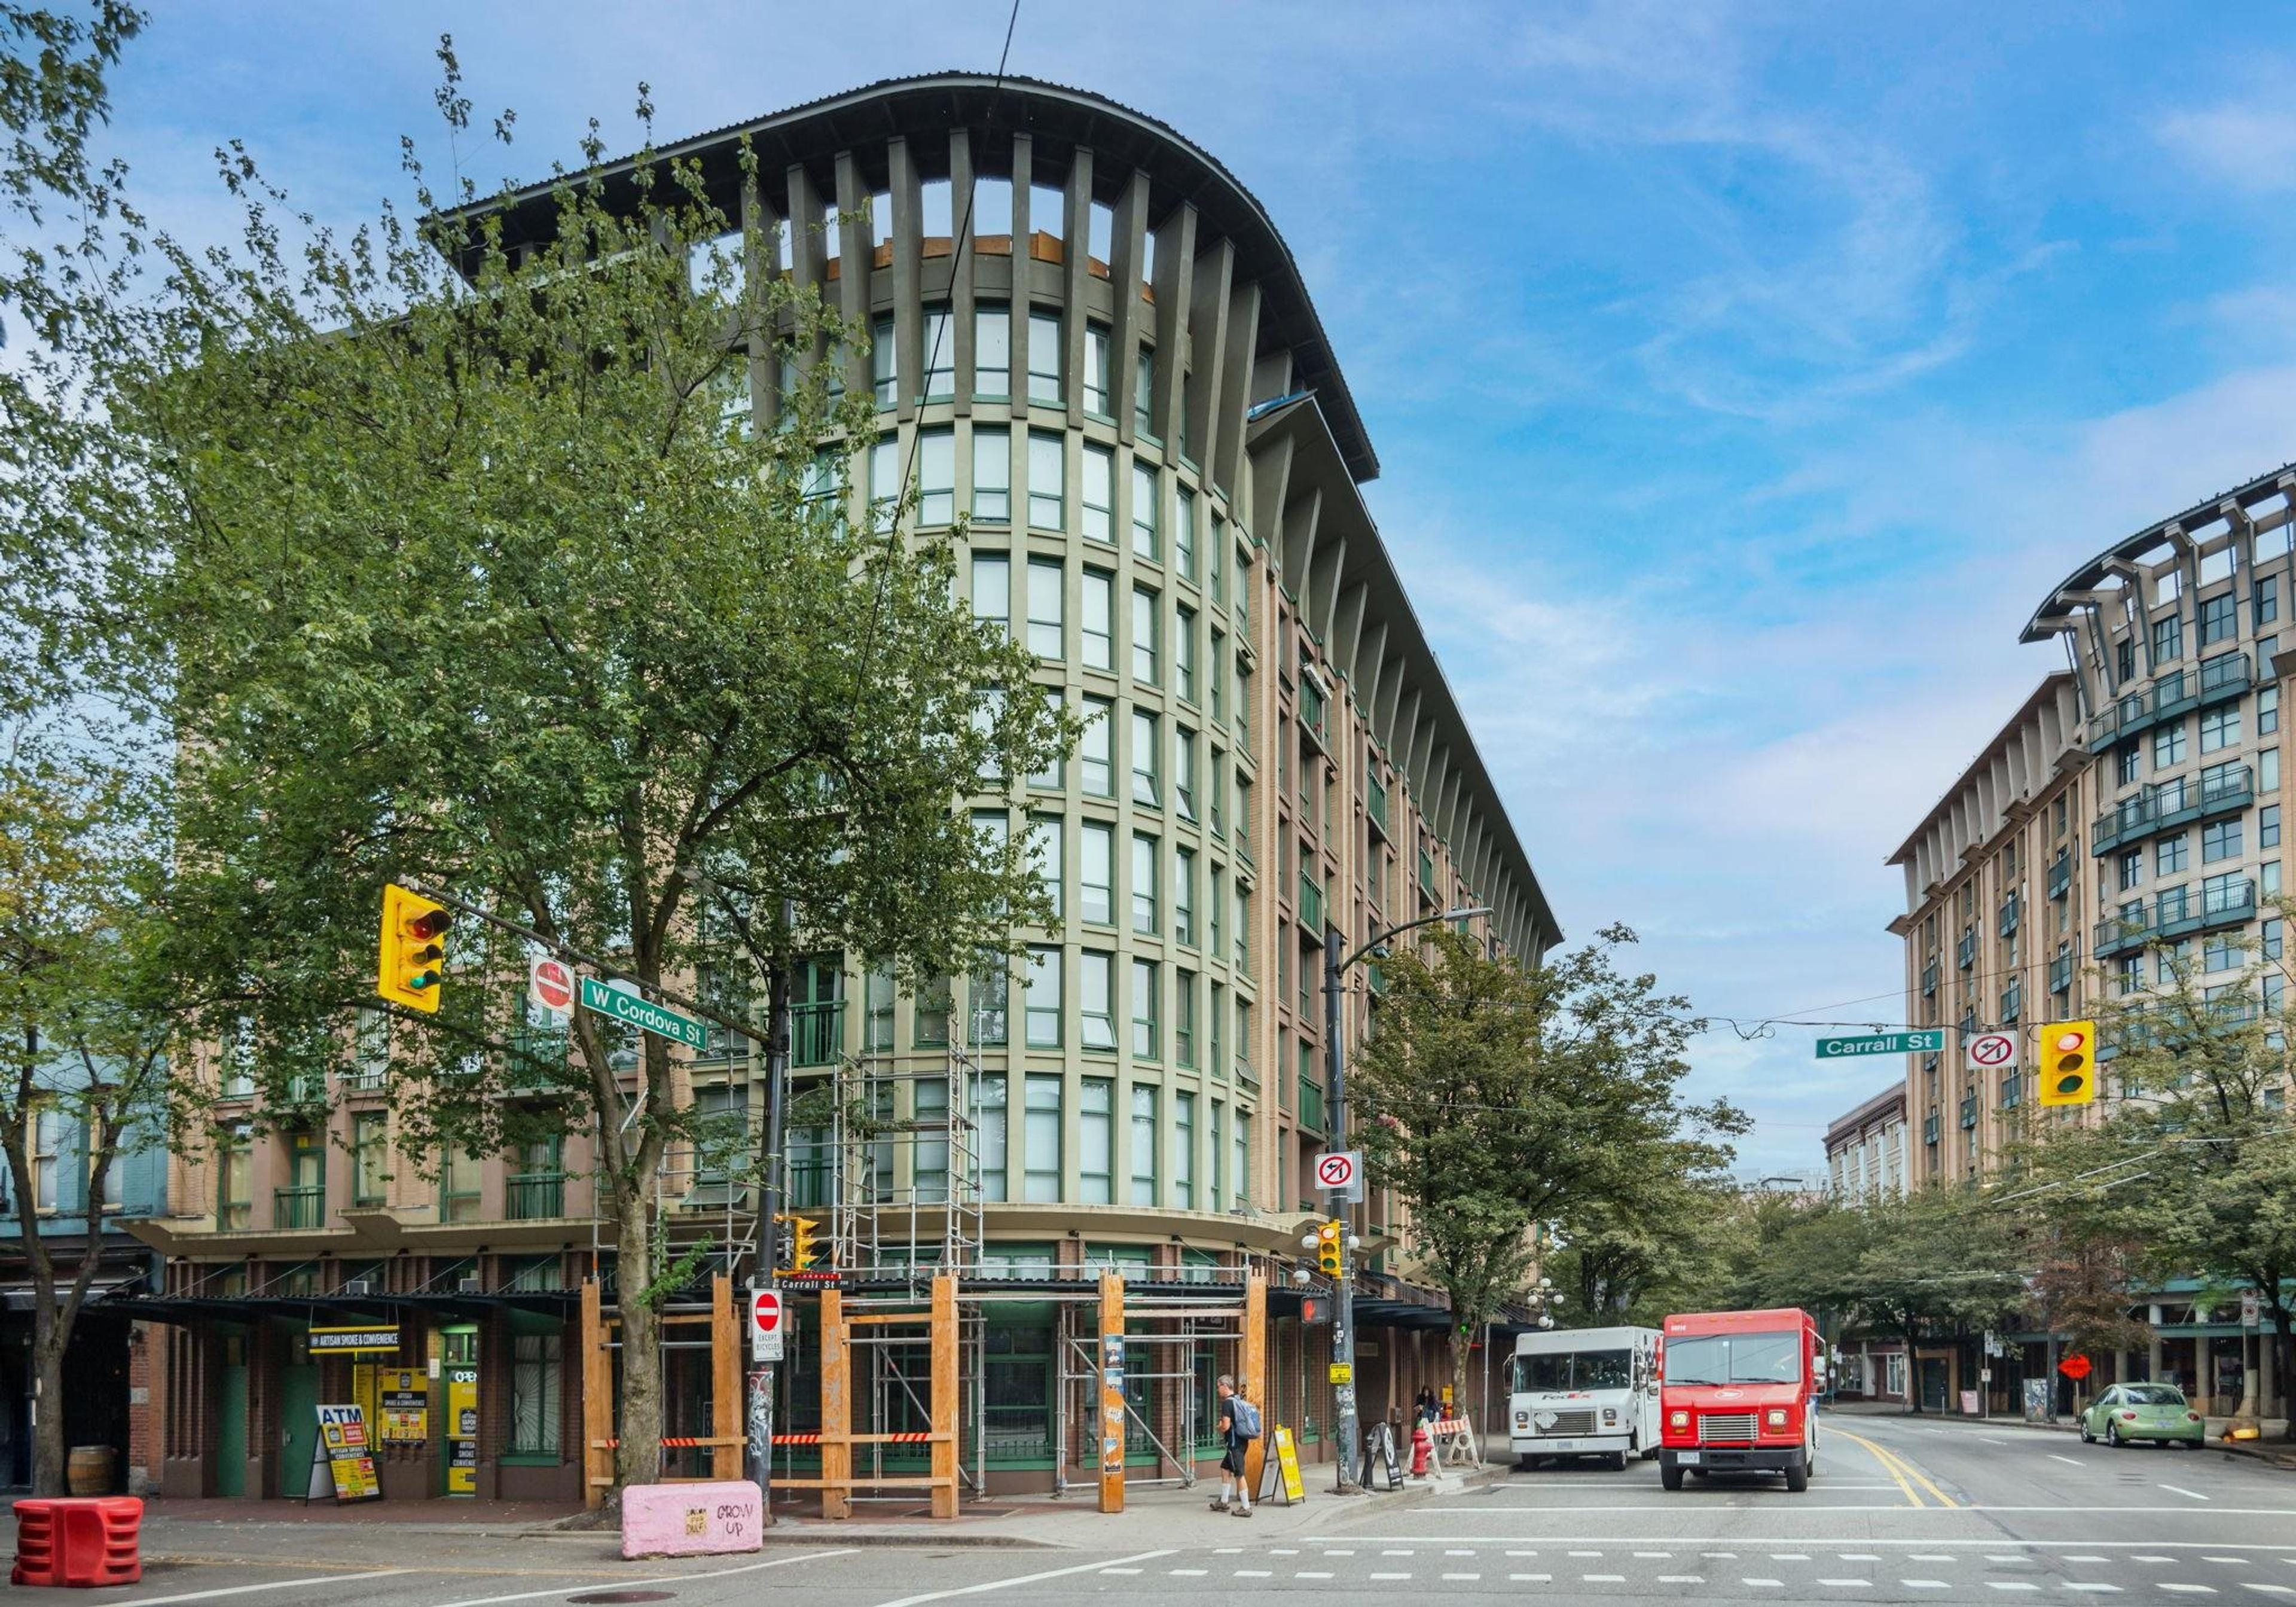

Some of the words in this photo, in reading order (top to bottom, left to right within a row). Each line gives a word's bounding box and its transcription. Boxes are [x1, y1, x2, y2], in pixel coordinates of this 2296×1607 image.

[592, 986, 610, 1007] W
[616, 997, 680, 1035] Cordova
[686, 1024, 701, 1044] St
[1826, 1037, 1897, 1054] Carrall
[1907, 1035, 1932, 1048] St
[320, 1335, 340, 1346] ARTISAN
[341, 1334, 358, 1345] SMOKE
[359, 1334, 362, 1345] &
[363, 1333, 398, 1344] CONVENIENCE
[323, 1408, 362, 1423] ATM
[718, 1504, 753, 1519] GROW
[726, 1521, 743, 1536] UP
